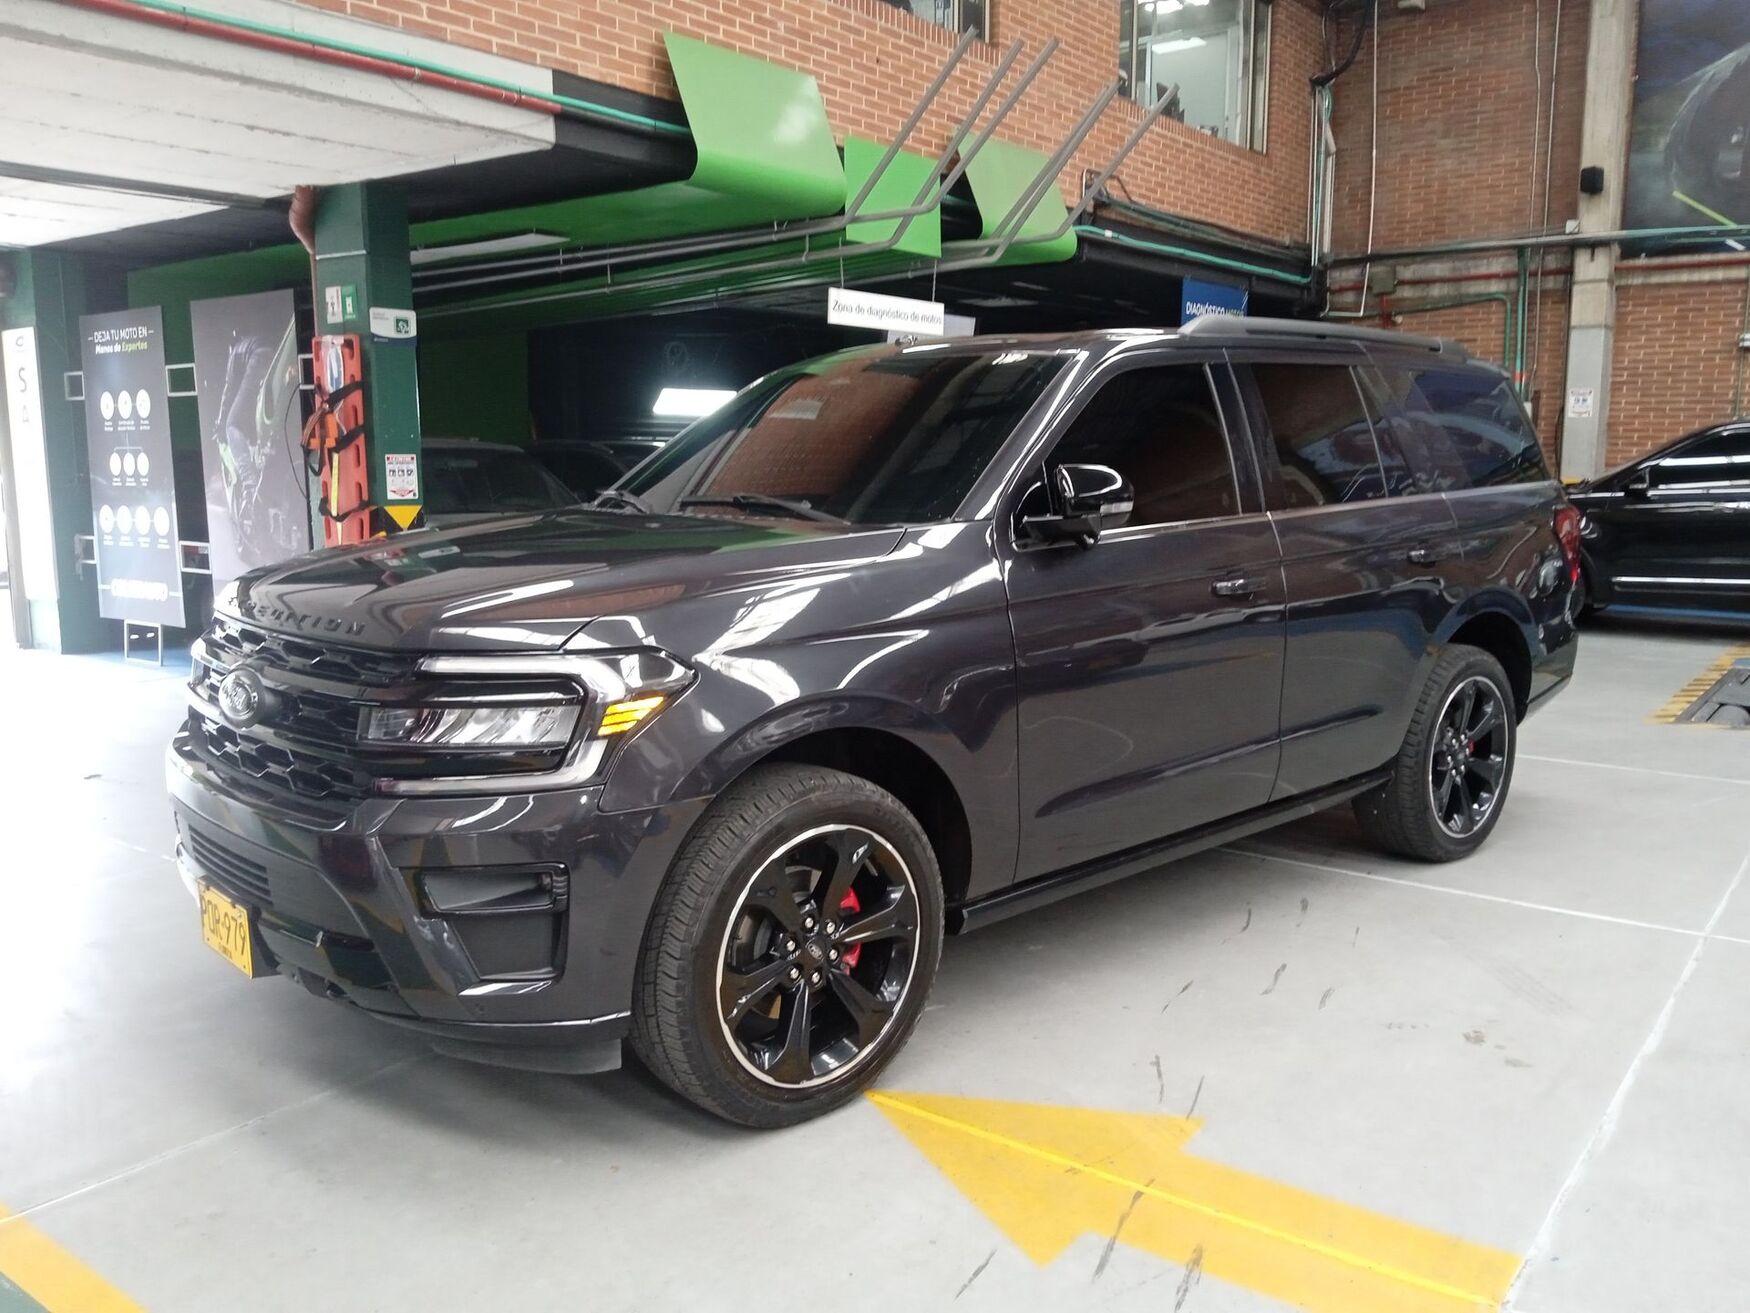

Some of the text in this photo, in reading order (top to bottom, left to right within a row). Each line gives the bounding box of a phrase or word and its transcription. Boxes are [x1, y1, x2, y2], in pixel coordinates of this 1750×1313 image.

[833, 300, 942, 325] Zona de diagnóstico de motos
[1186, 301, 1225, 316] DIAGNÓSTICO
[94, 326, 147, 342] DEJA TU MOTO EN
